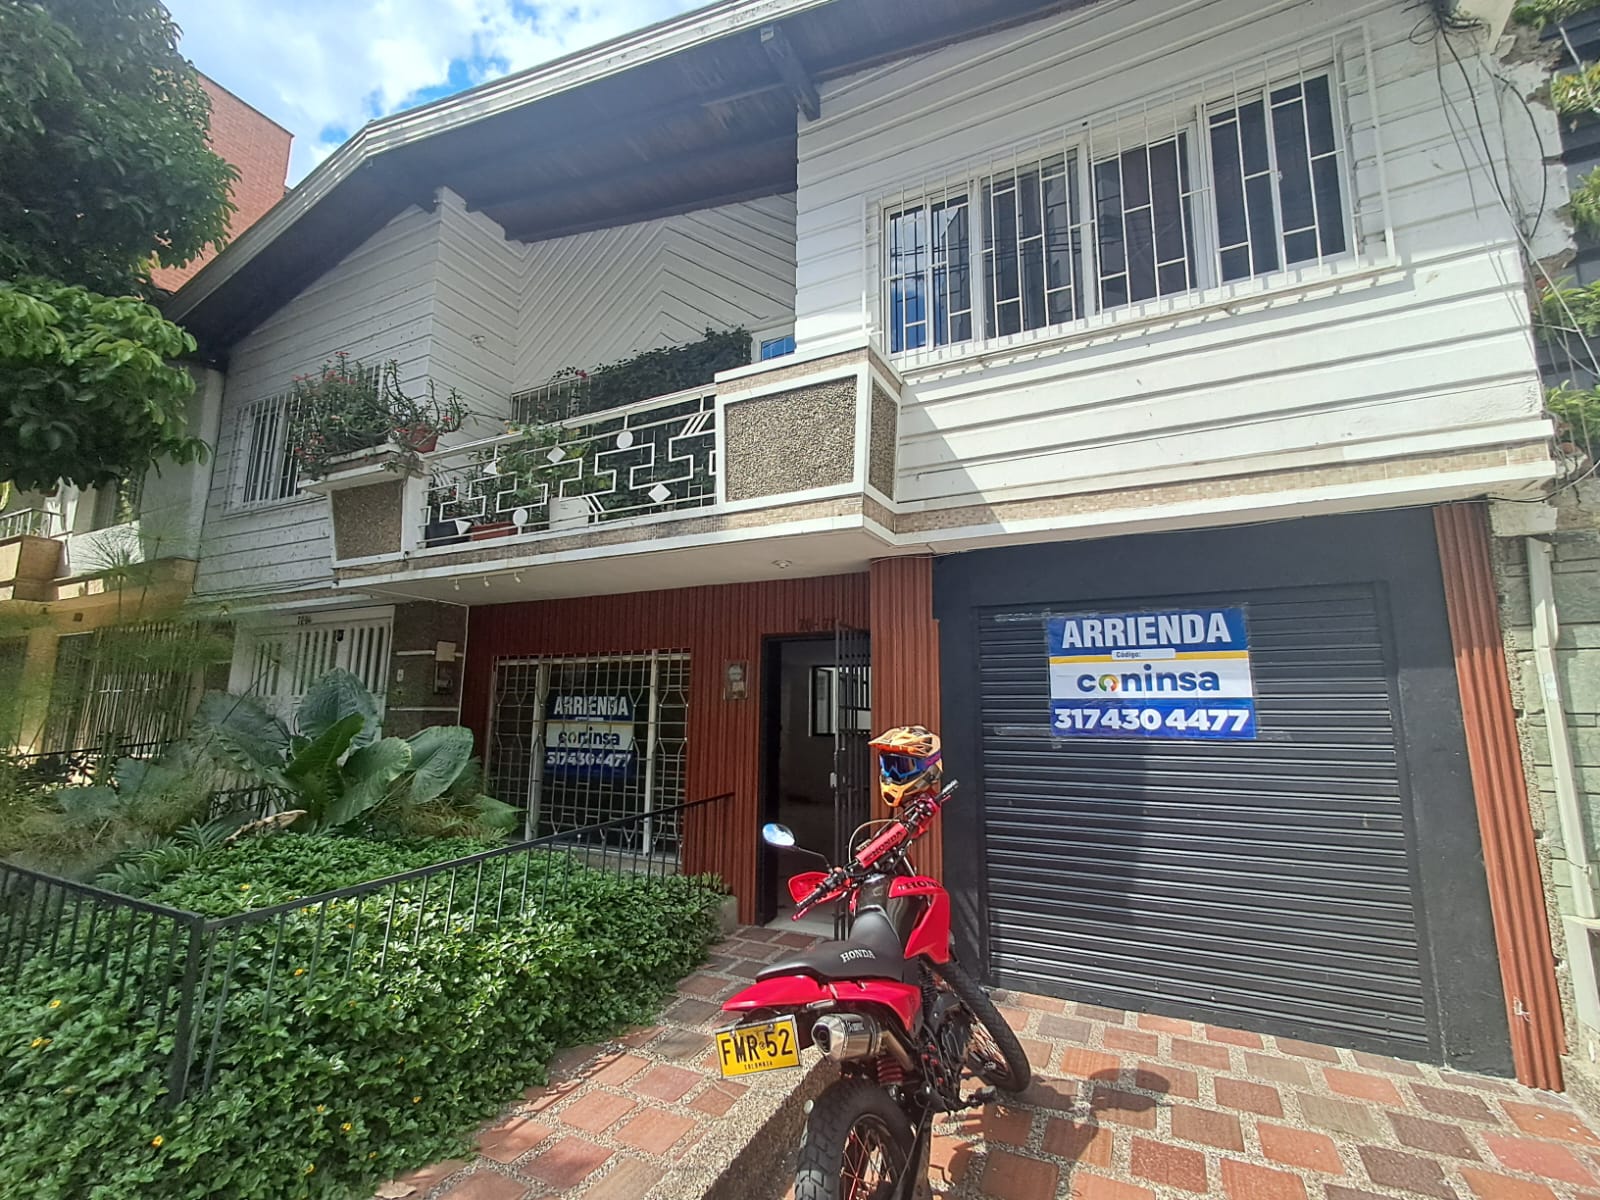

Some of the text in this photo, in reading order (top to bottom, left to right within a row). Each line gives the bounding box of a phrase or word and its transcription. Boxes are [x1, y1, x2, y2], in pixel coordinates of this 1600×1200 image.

[1062, 612, 1232, 648] ARRIENDA
[1077, 663, 1220, 692] coninsa
[554, 696, 628, 716] ARRIENDA
[559, 726, 620, 745] coninsa
[872, 831, 903, 854] HONDA
[840, 950, 876, 963] HONDA
